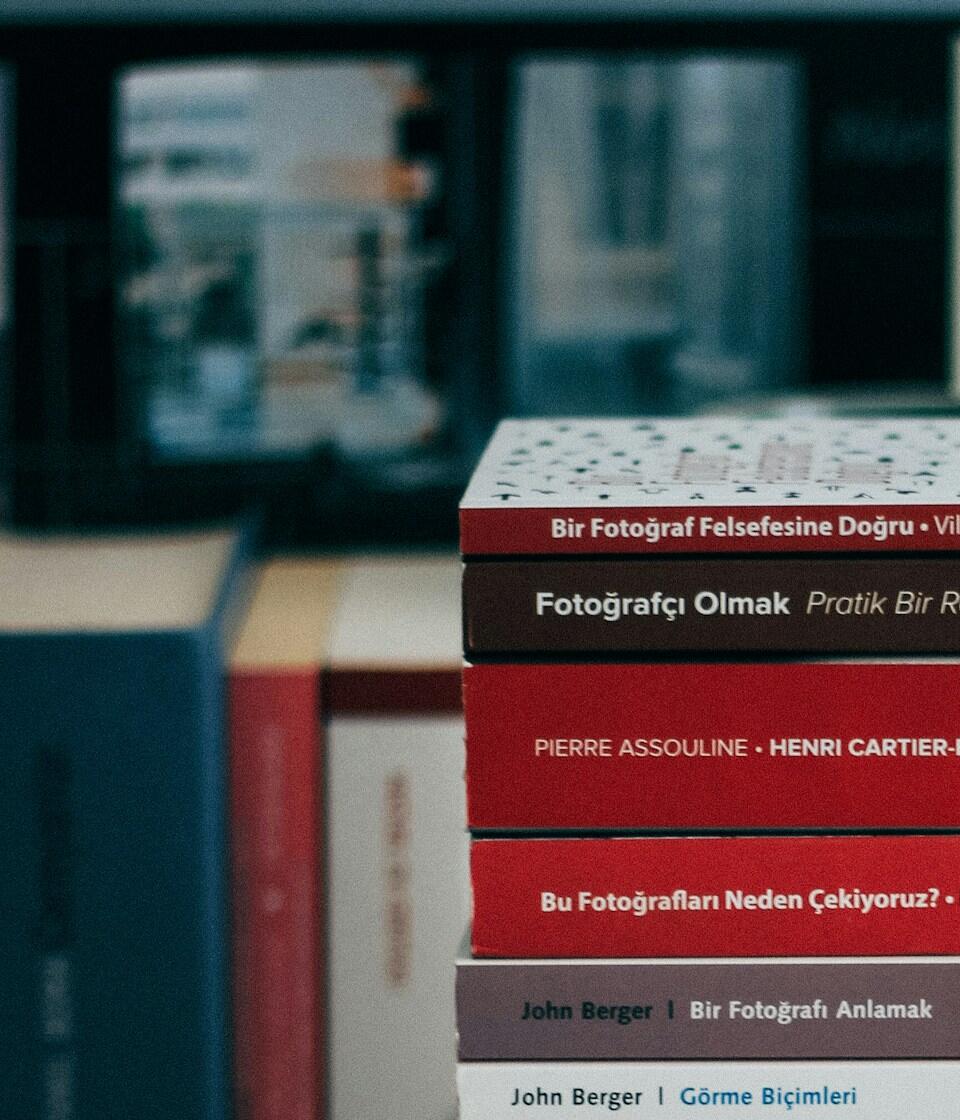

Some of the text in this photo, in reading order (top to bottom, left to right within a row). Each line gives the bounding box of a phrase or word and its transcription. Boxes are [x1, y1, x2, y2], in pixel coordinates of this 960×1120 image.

[551, 517, 586, 539] Bir
[590, 515, 696, 544] Fotoğraf
[699, 515, 834, 537] Felsefesine
[838, 515, 915, 542] Doğru
[536, 591, 686, 622] Fotoğrafçı
[693, 590, 791, 616] Olmak
[806, 590, 888, 616] Pratik
[894, 590, 934, 615] Bir
[534, 737, 612, 758] PIERRE
[618, 737, 748, 758] ASSOULINE
[769, 737, 842, 757] HENRI
[540, 891, 573, 913] Bu
[577, 888, 720, 917] Fotoğrafları
[724, 888, 804, 910] Neden
[807, 887, 941, 915] Çekiyoruz?
[520, 998, 933, 1026] John Berger Bir Fotoğrafı Anlamak
[511, 1085, 857, 1112] John Berger Görme Biçimleri
